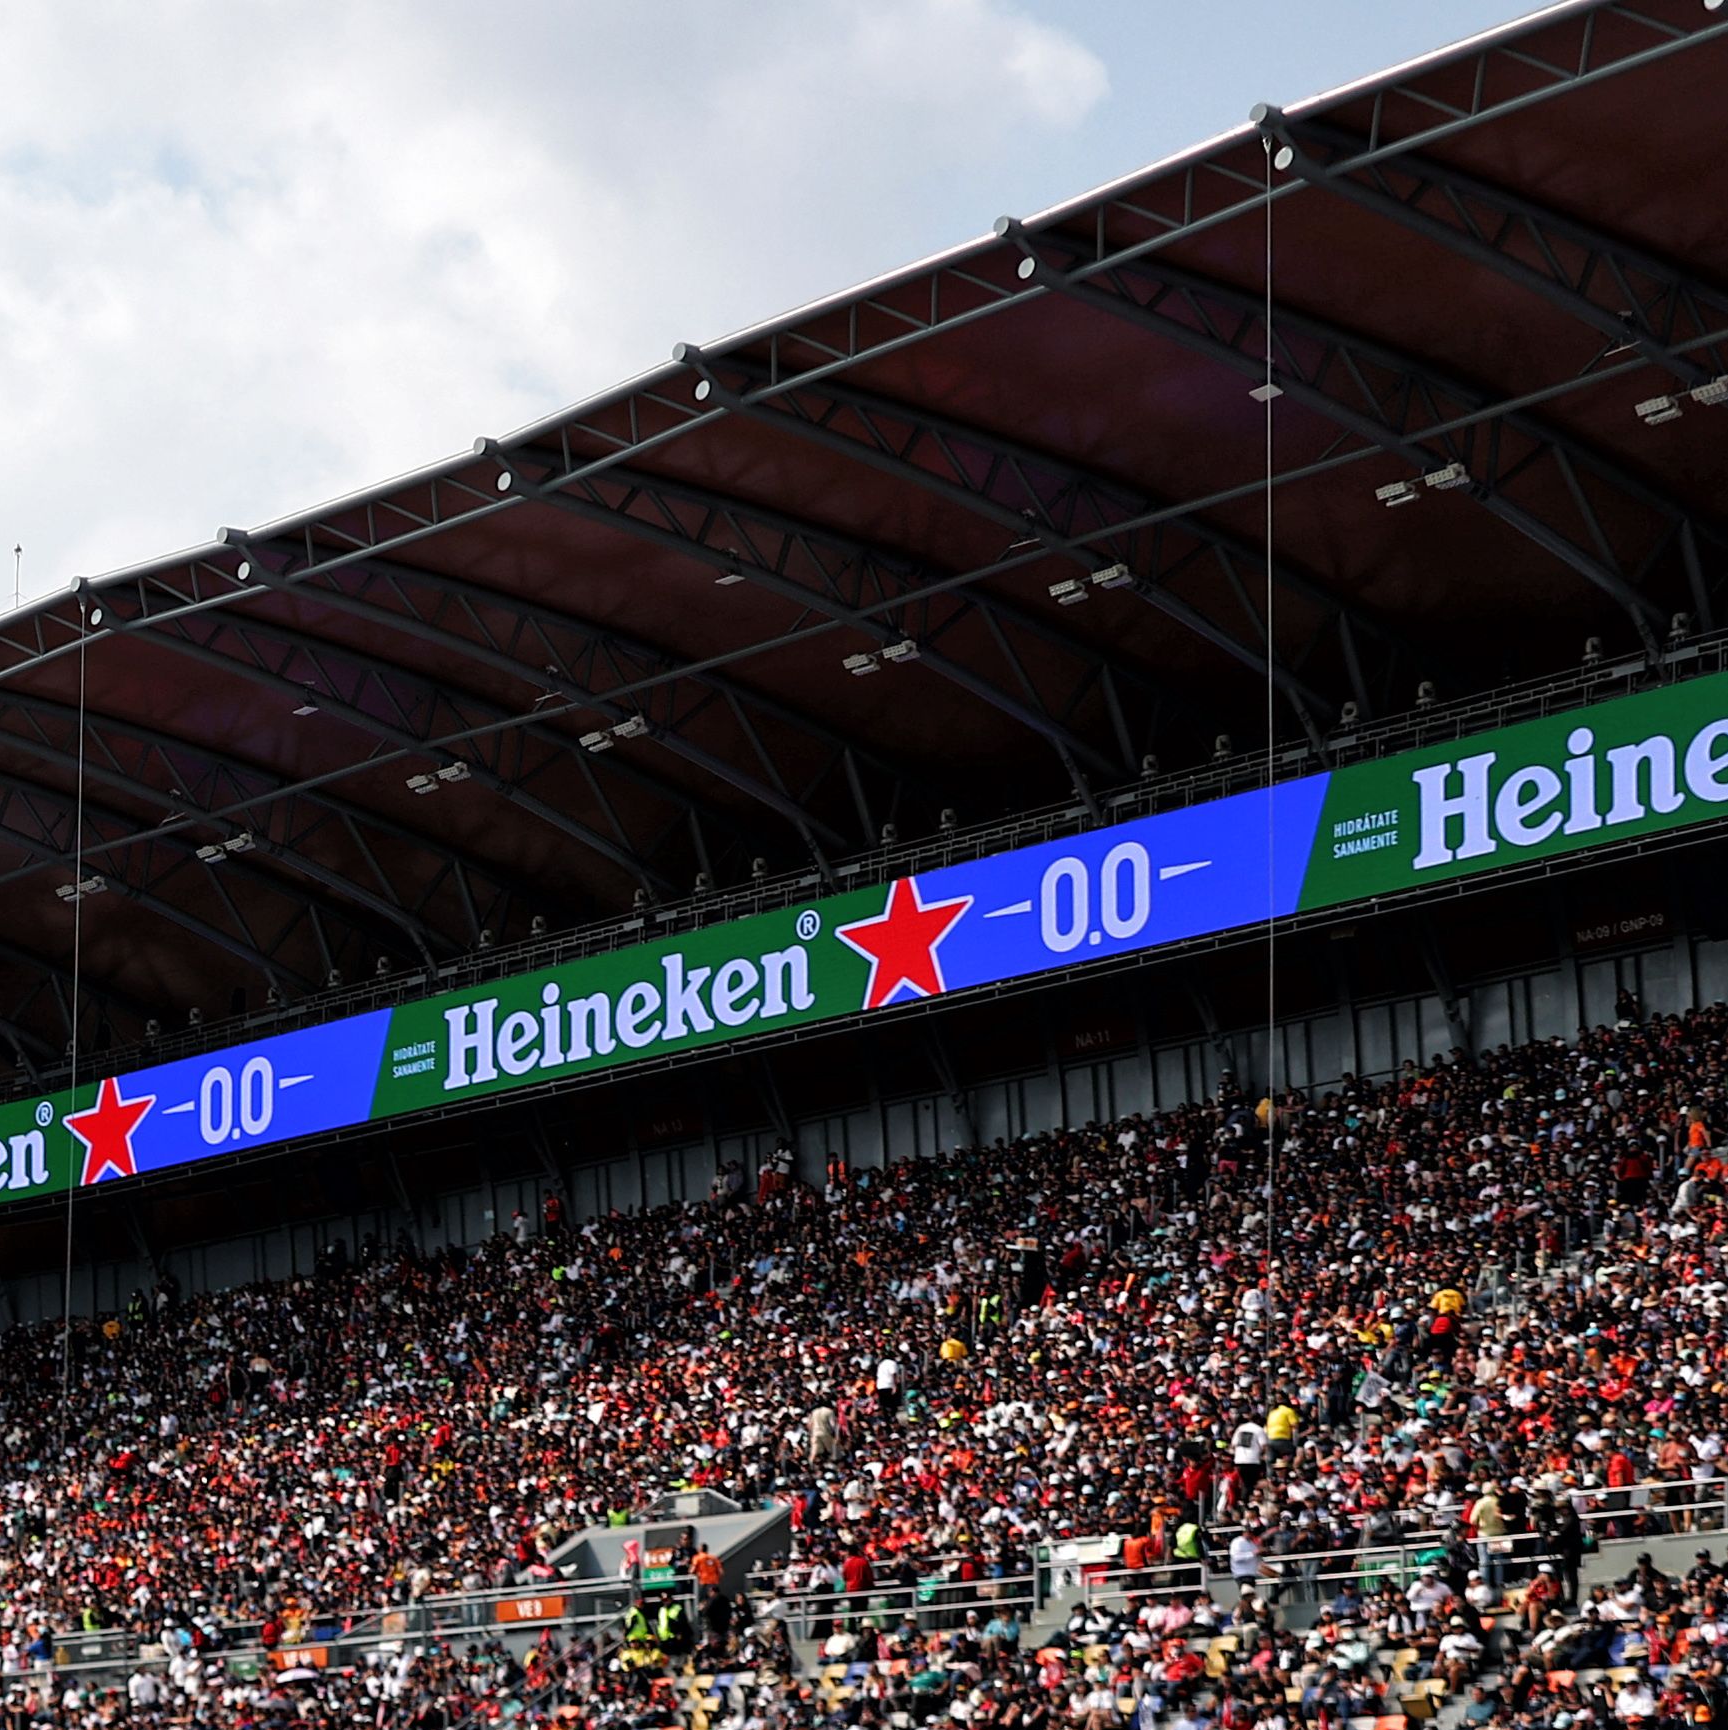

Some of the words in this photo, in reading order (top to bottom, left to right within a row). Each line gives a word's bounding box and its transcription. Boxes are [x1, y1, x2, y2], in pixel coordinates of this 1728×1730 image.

[1334, 809, 1398, 838] HIDRÁTATE
[1333, 830, 1398, 859] SANAMENTE
[1040, 842, 1150, 953] 0.0
[393, 1058, 436, 1078] SANAMENTE
[199, 1056, 273, 1145] 0.0
